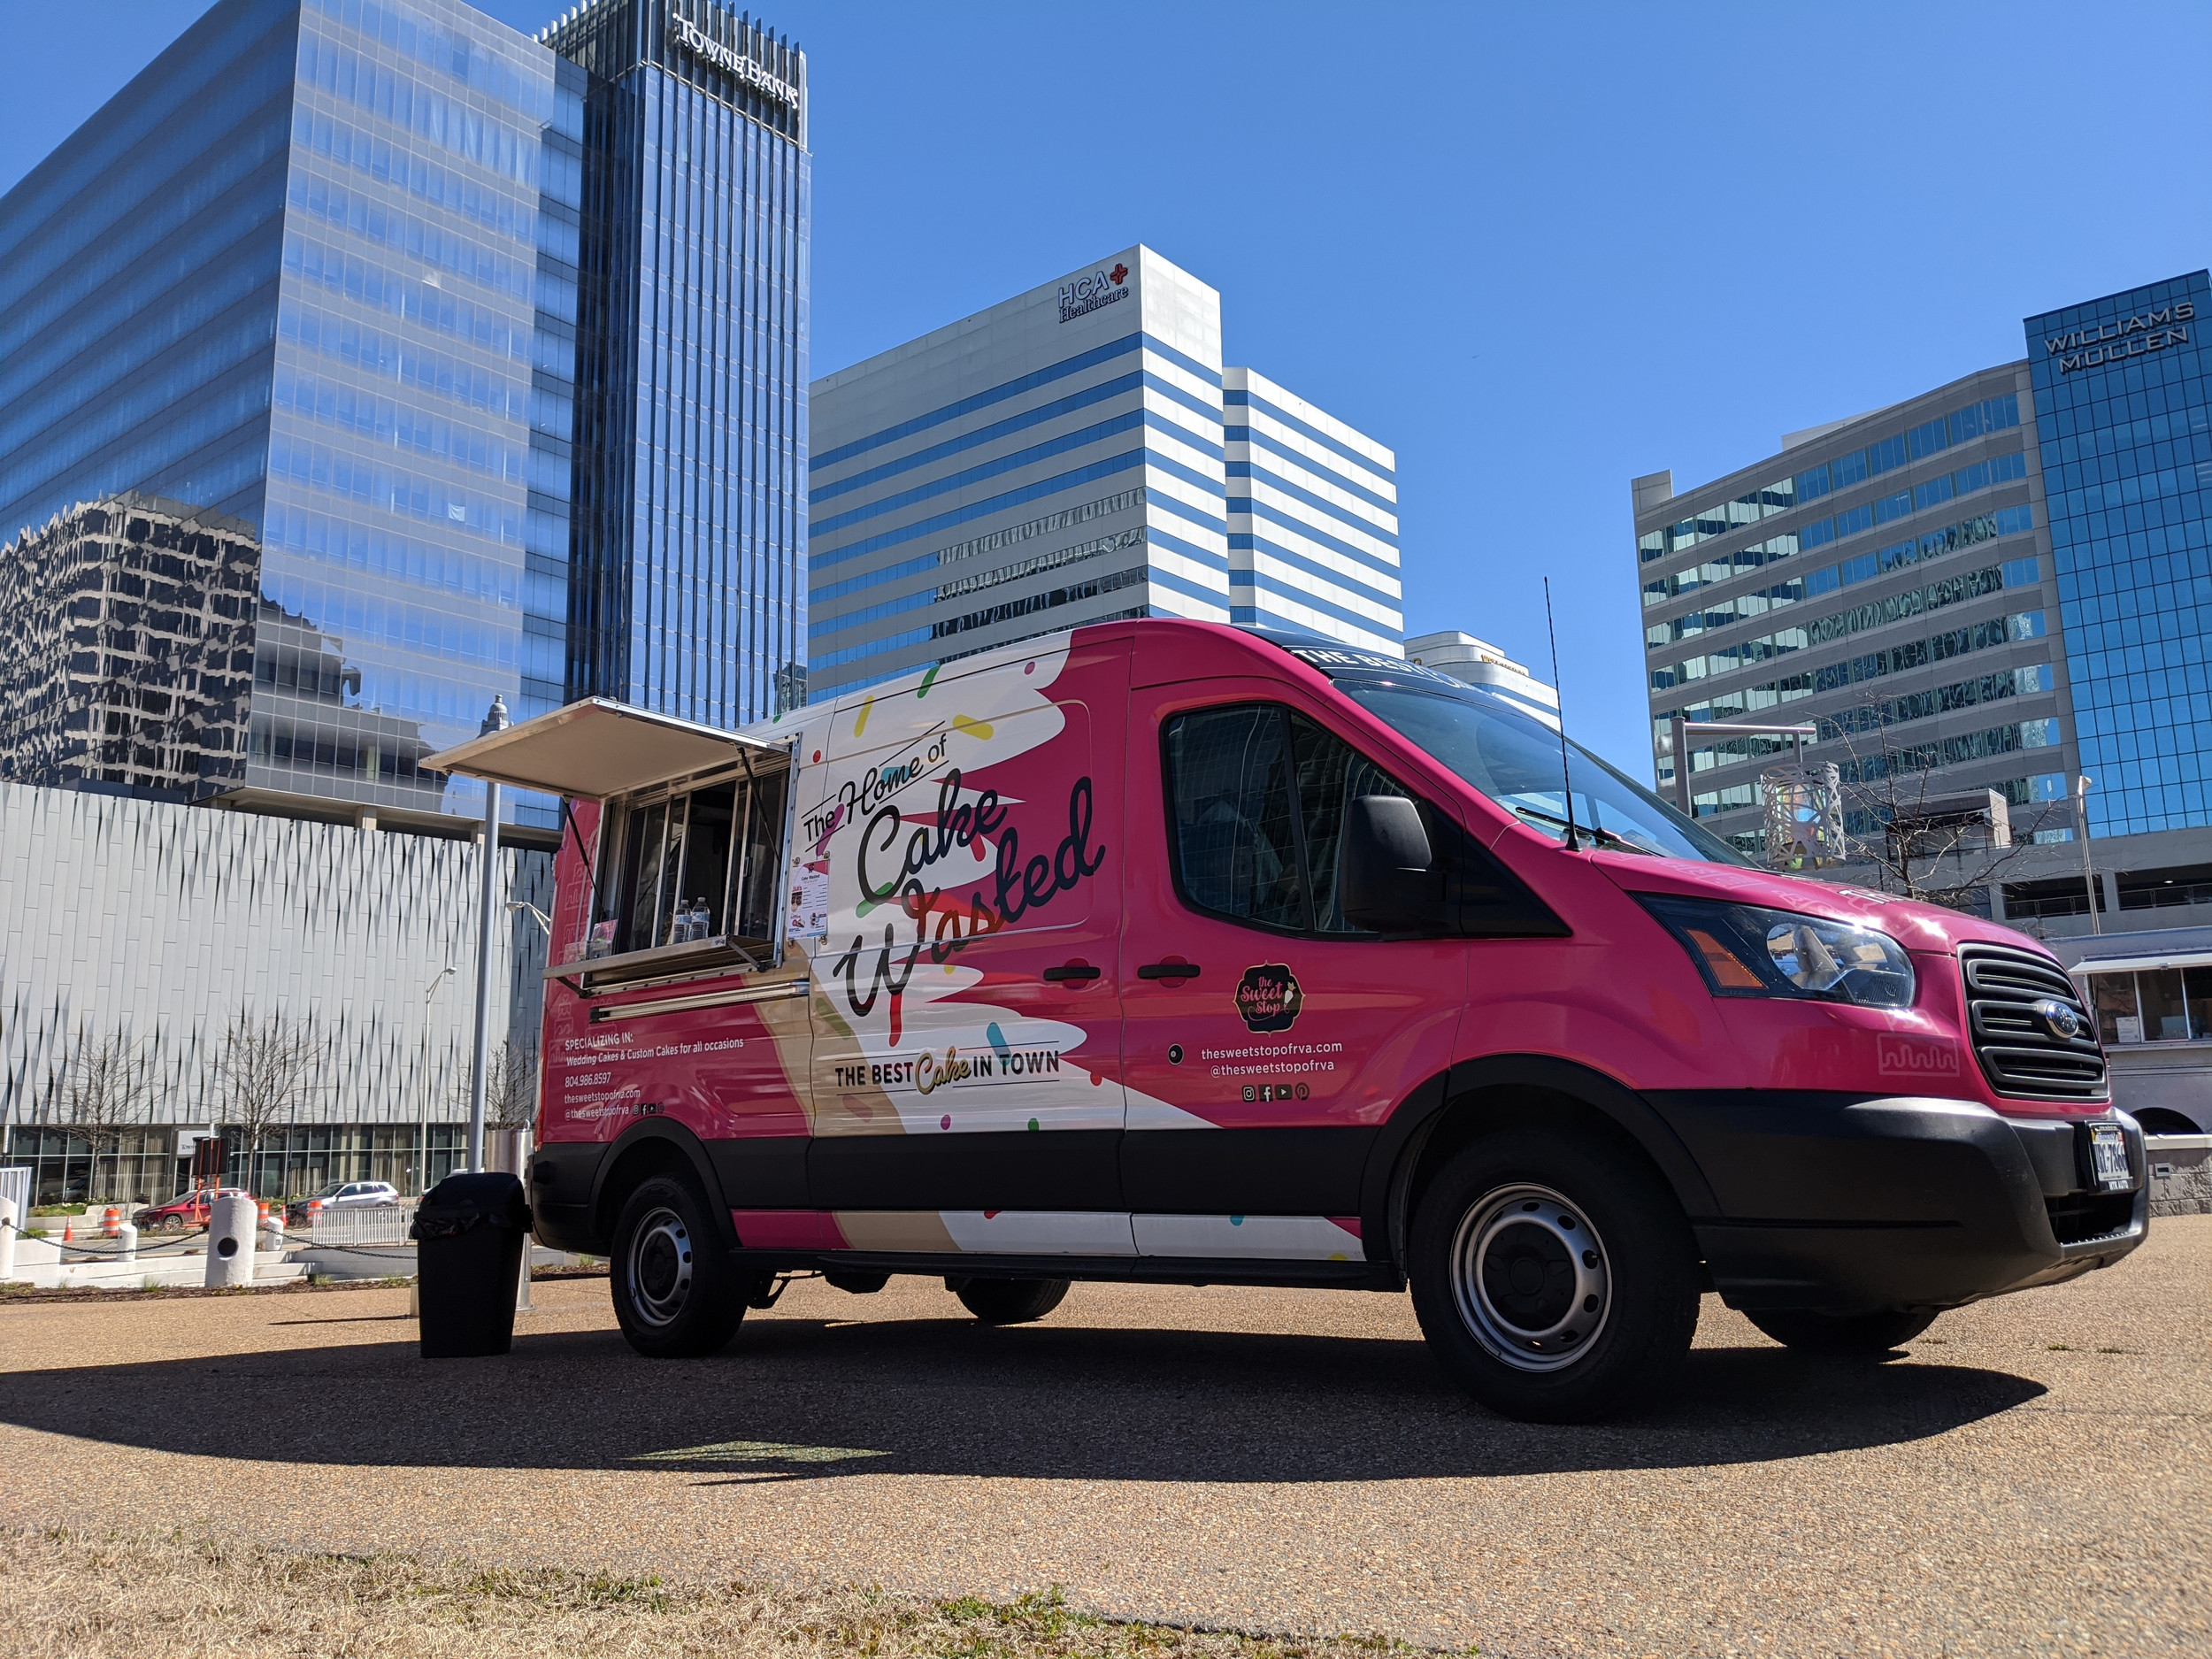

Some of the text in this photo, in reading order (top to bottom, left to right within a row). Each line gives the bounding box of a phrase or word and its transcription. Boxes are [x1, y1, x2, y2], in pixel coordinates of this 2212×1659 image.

[1058, 270, 1110, 309] HCA
[1059, 286, 1129, 323] Healthcare
[2044, 302, 2194, 353] WILLIAMS
[2058, 326, 2189, 374] MULLEN
[1290, 649, 1359, 664] THE
[803, 733, 947, 841] The Home of
[857, 768, 1007, 905] Cake
[833, 776, 1105, 1017] Wasted
[1240, 981, 1283, 1002] Sweet
[1258, 976, 1272, 987] the
[1256, 1001, 1280, 1017] Stop
[565, 1032, 634, 1051] SPECIALIZING IN:
[567, 1037, 744, 1066] Wedding Cakes & Custom Cakes for all occasions
[1202, 1042, 1343, 1060] thesweetstopofrva.com
[565, 1072, 611, 1087] 804.986.8597
[835, 1046, 1059, 1094] THE BEST Cake IN TOWN
[1210, 1060, 1334, 1079] @thesweetstopofrva
[565, 1089, 641, 1104] thesweetstopofrva.com
[565, 1104, 629, 1121] @thesweetstopofrva
